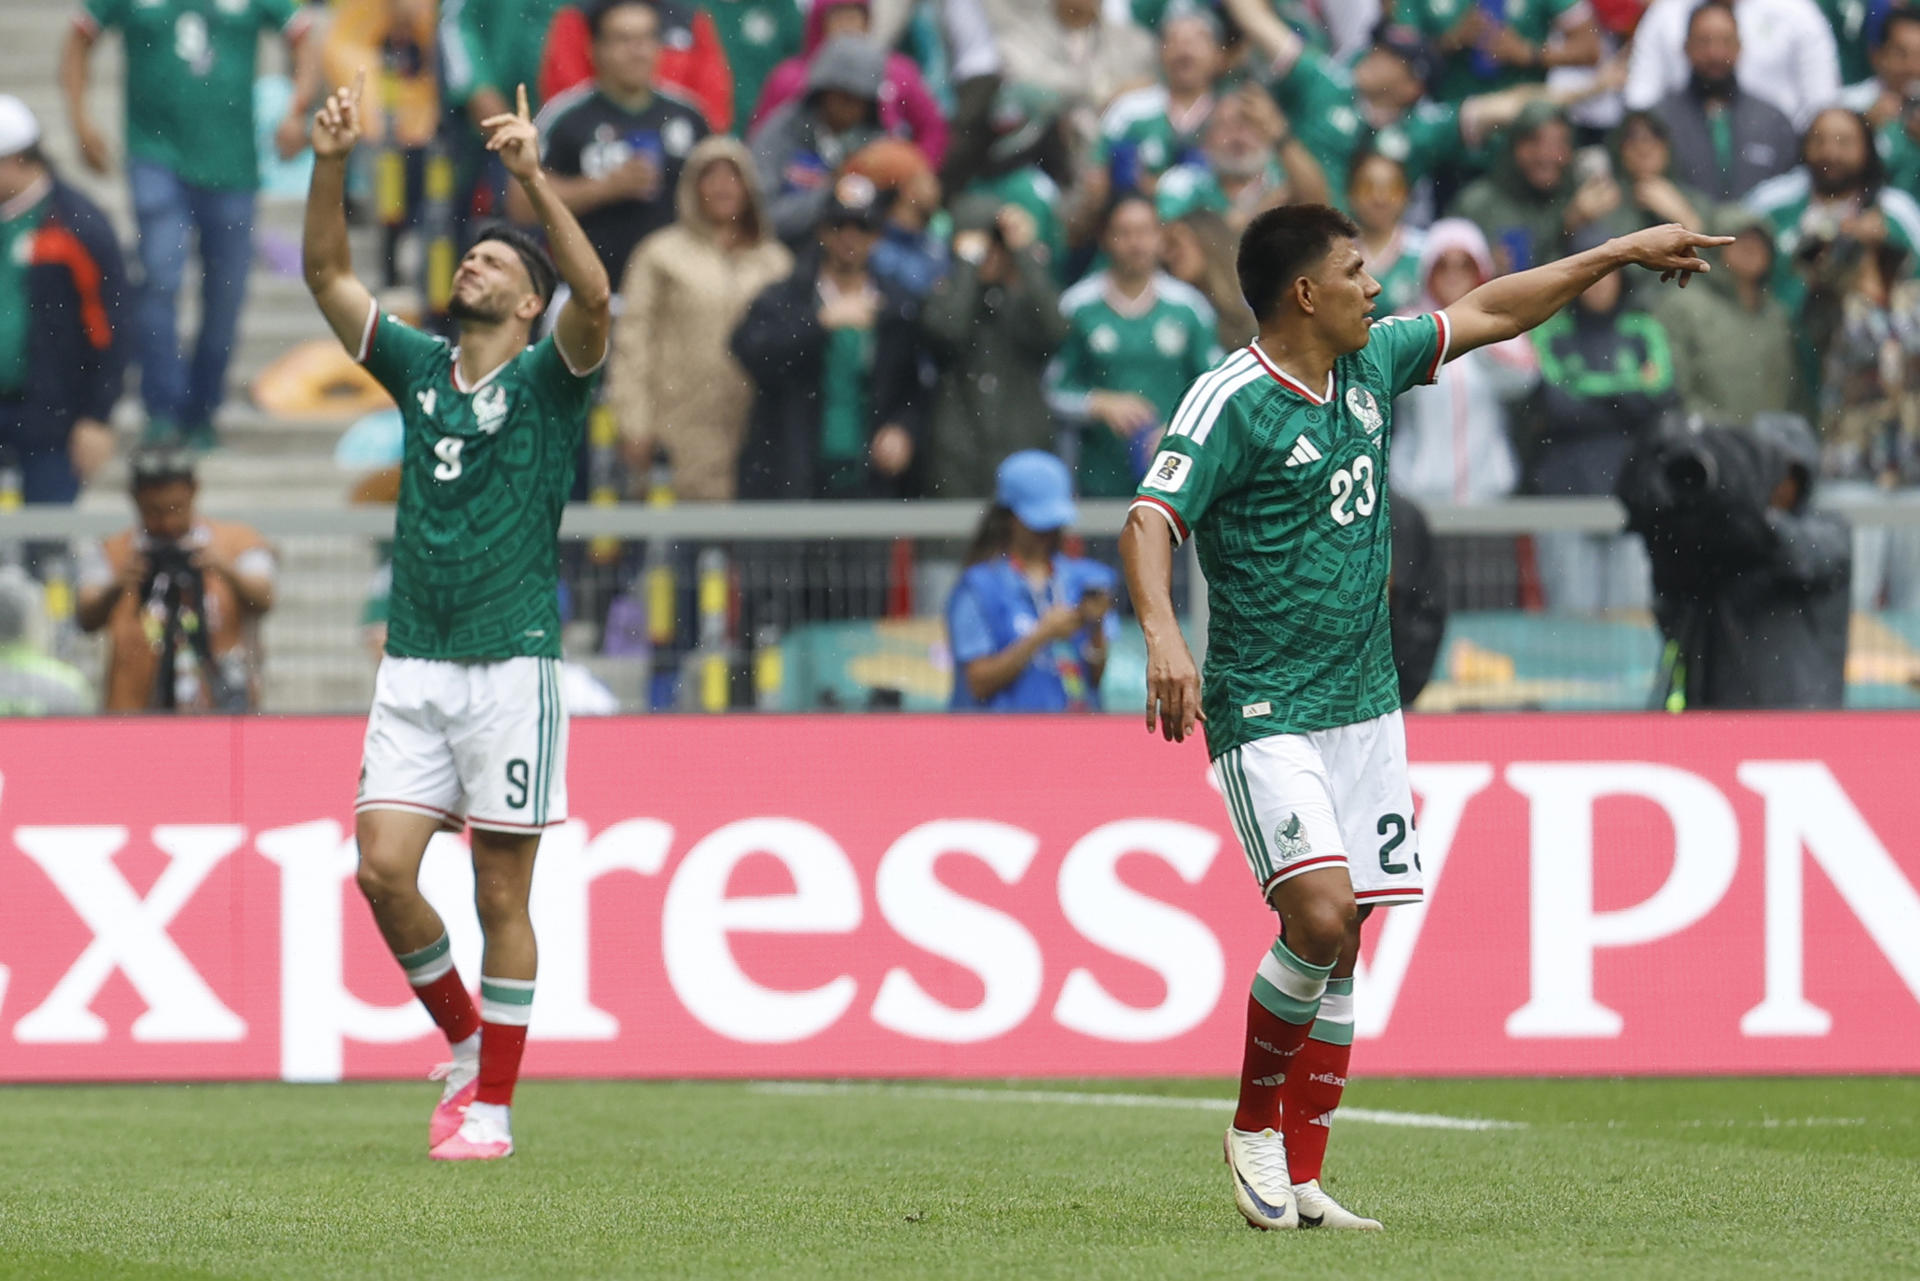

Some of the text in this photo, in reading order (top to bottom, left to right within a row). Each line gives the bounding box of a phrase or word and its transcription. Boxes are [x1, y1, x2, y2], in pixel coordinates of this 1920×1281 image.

[434, 436, 465, 481] 9
[1330, 454, 1376, 526] 23
[506, 758, 529, 809] 9
[1376, 813, 1422, 875] 2
[0, 759, 1920, 1083] xpressPN
